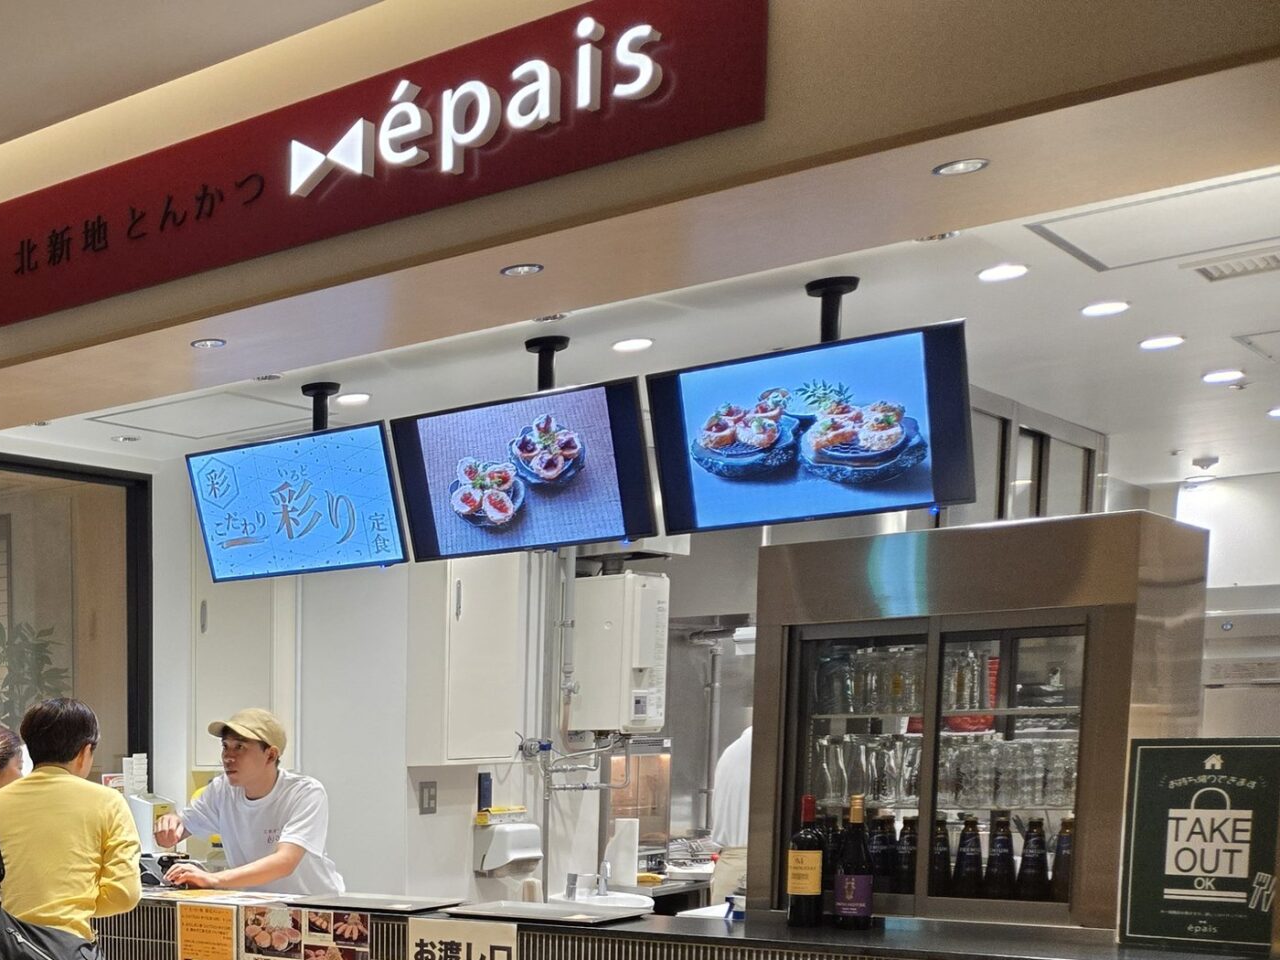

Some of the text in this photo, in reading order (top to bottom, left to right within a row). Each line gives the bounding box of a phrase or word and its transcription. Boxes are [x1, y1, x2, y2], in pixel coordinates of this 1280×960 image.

[377, 16, 661, 173] épais
[13, 171, 265, 277] 北新地 とんかつ
[206, 467, 231, 499] 彩
[214, 510, 267, 537] こだわり
[270, 479, 356, 545] 彩り
[368, 512, 391, 555] 定食
[1168, 774, 1258, 790] お持ち帰りできます
[1168, 817, 1252, 844] TAKE
[1174, 847, 1243, 875] OUT
[1193, 877, 1216, 890] OK
